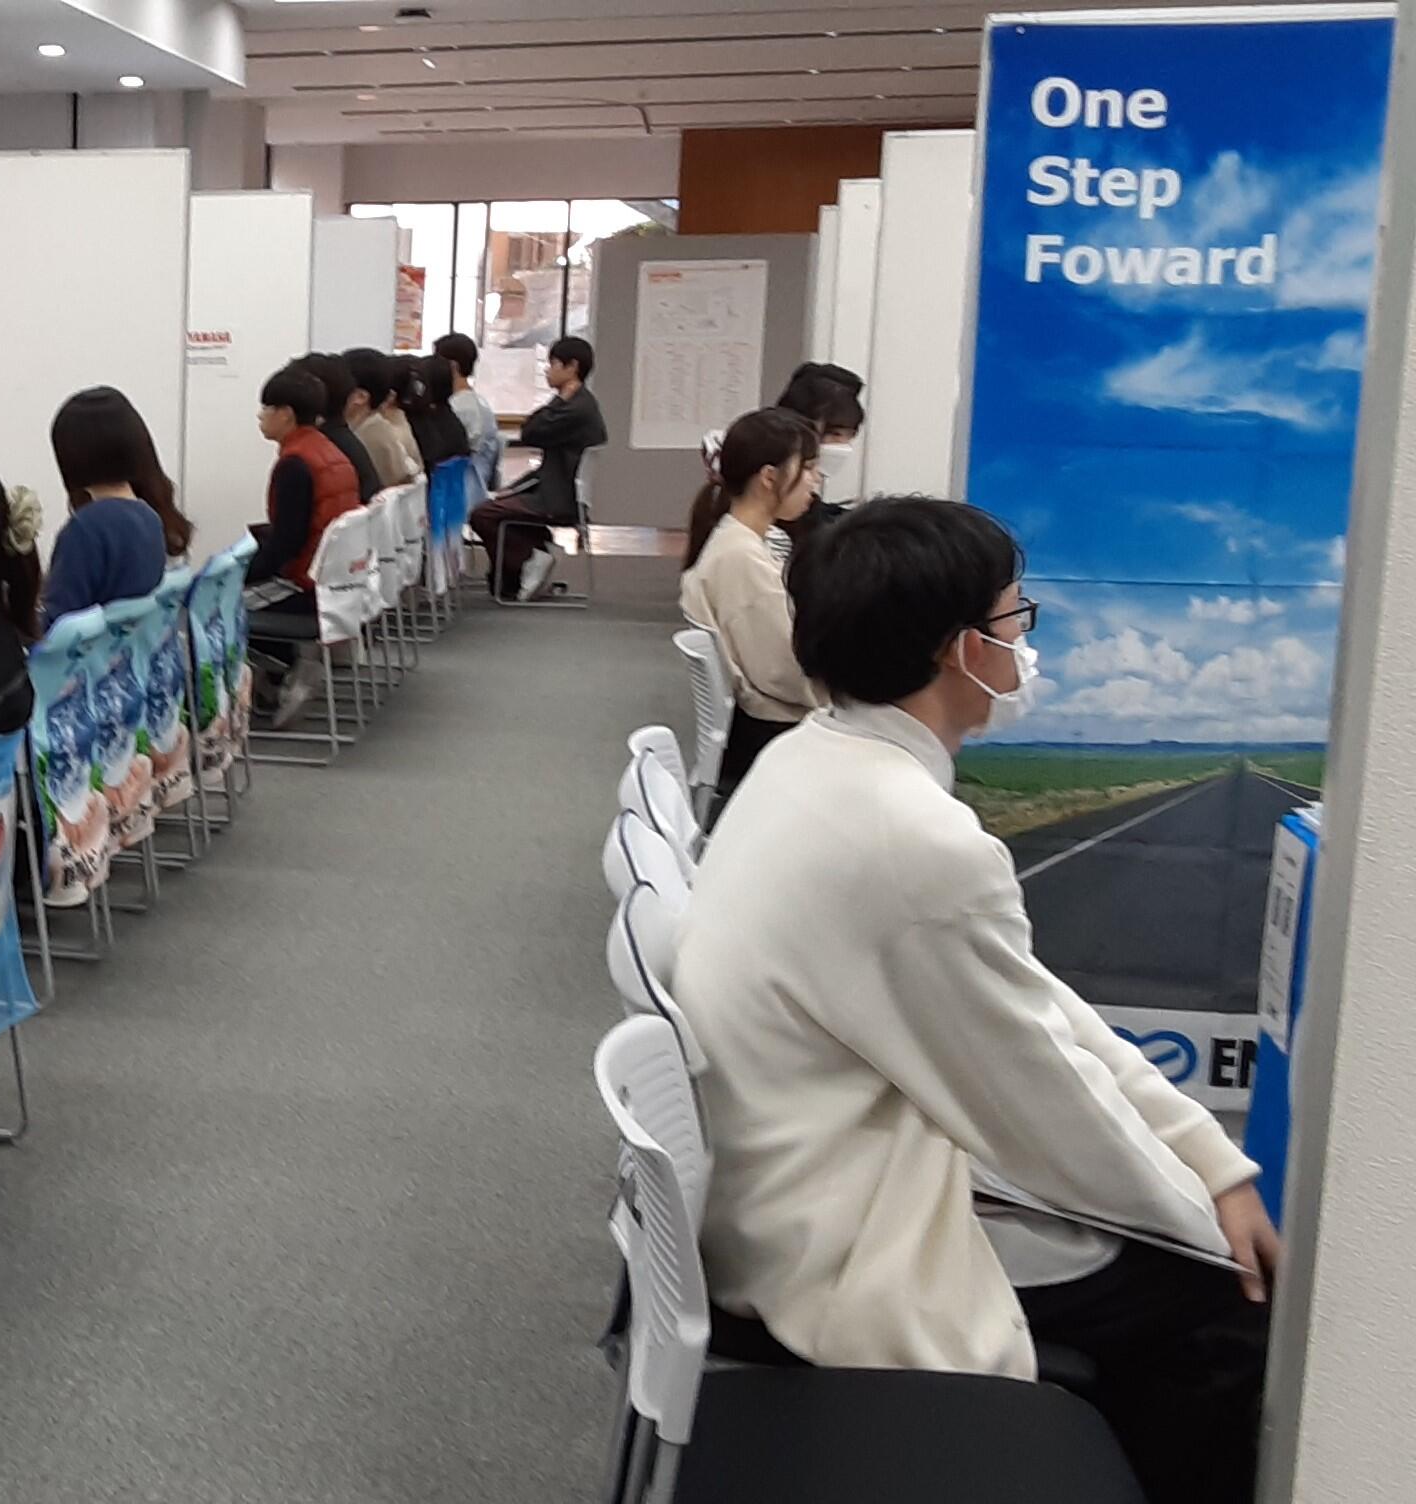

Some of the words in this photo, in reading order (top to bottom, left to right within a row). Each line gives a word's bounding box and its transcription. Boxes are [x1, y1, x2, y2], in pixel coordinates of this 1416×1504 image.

[1031, 76, 1168, 129] One
[1026, 155, 1181, 219] Step
[1024, 233, 1278, 286] Foward
